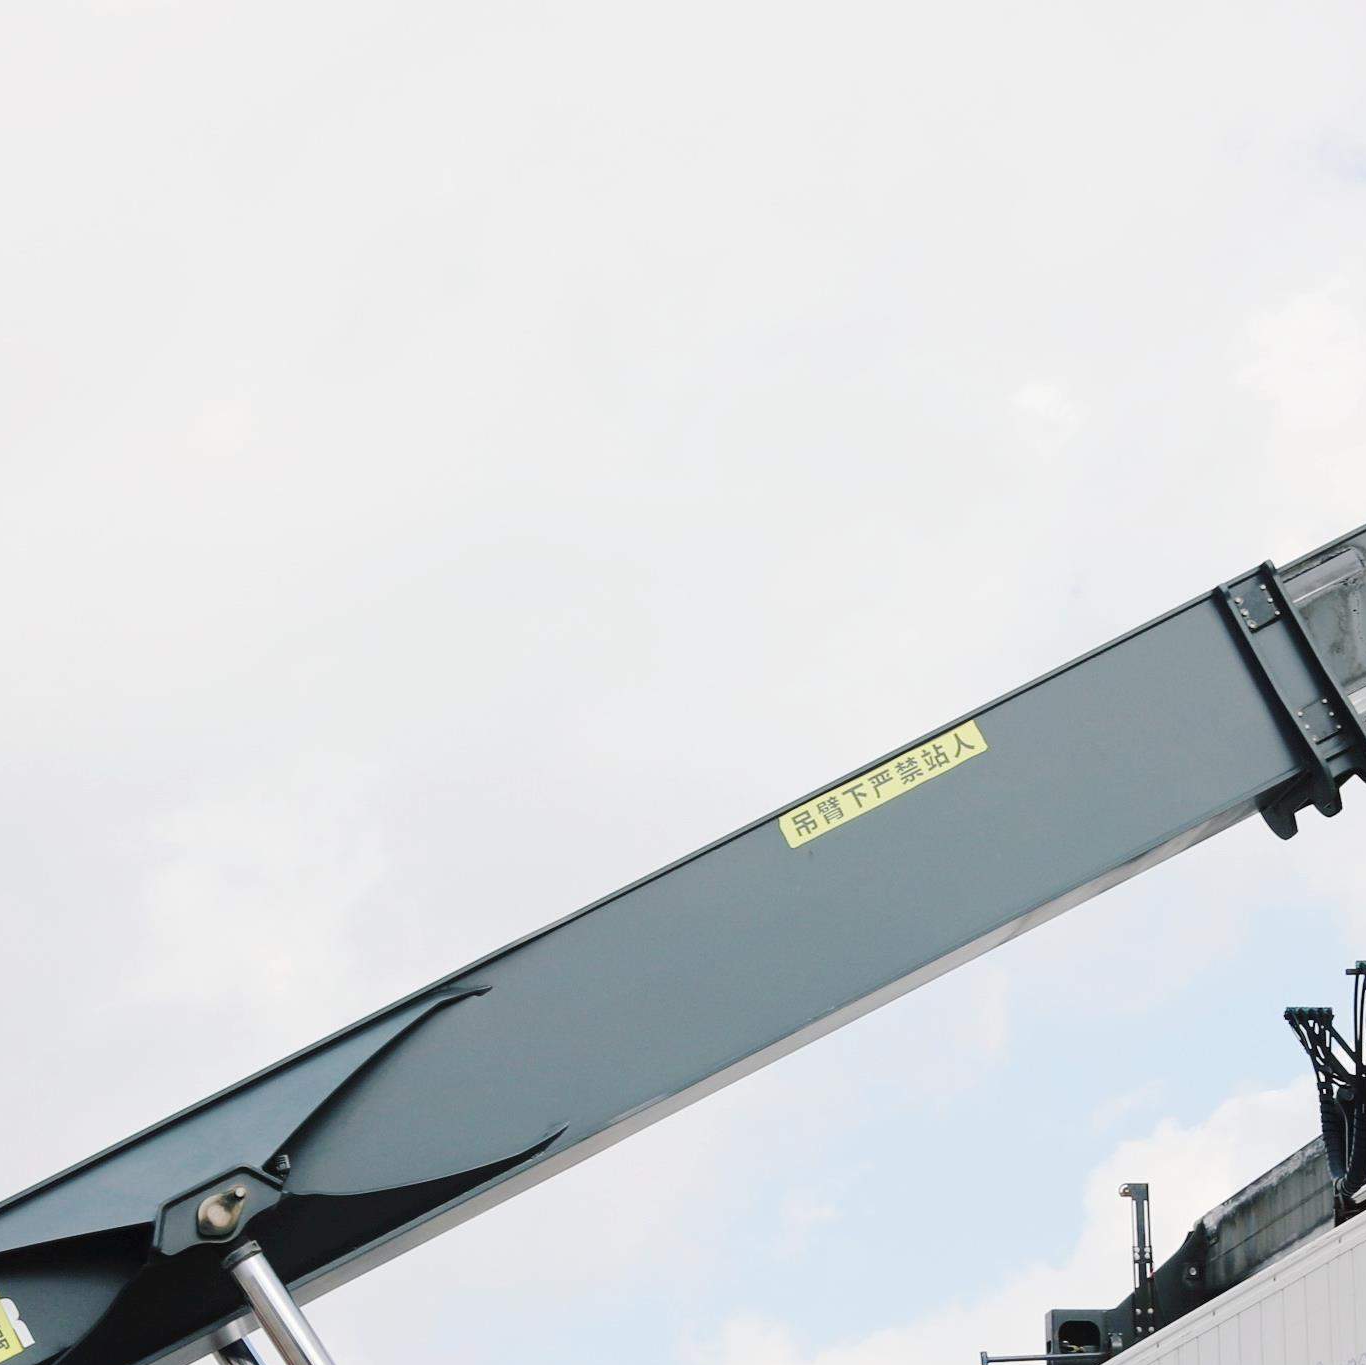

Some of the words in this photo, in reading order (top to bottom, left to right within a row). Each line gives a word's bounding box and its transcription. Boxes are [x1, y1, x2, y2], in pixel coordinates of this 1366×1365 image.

[791, 733, 975, 836] 吊臂下严禁站人
